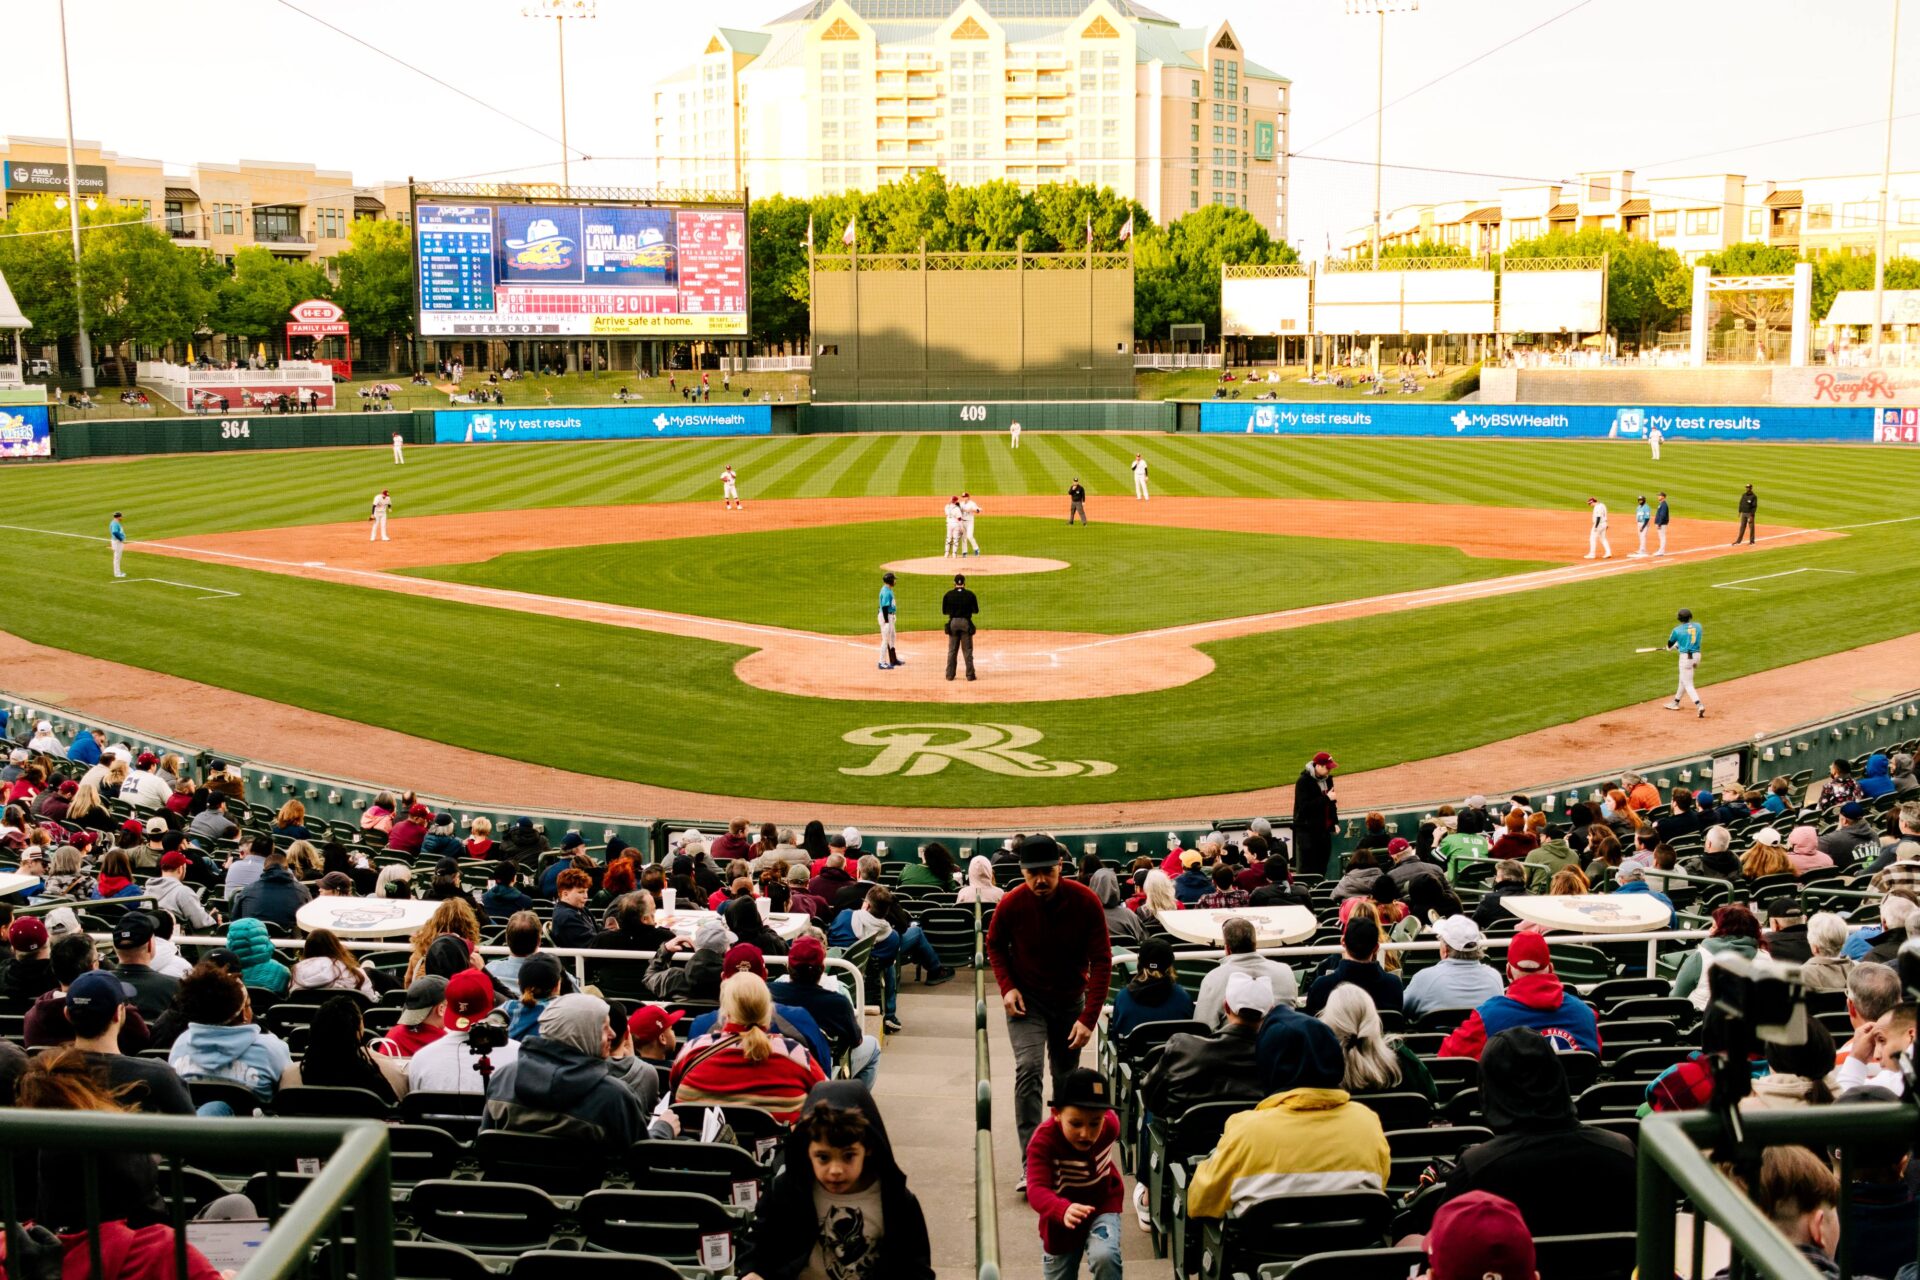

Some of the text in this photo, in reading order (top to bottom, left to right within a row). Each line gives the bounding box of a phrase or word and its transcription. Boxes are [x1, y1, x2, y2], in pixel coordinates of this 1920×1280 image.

[63, 178, 104, 187] COSSING
[586, 225, 614, 234] JORDAN
[616, 297, 650, 311] 2 0 1
[594, 316, 693, 326] Arrive safe at home.
[960, 405, 987, 421] 409
[1281, 412, 1372, 425] My test results
[1905, 410, 1916, 425] 0
[500, 417, 581, 430] My test results
[670, 414, 745, 427] MyBSWHealth
[1472, 414, 1569, 427] MyBSWHealth
[1650, 416, 1761, 430] My test results
[221, 420, 250, 438] 364
[1904, 428, 1914, 441] 4
[122, 777, 140, 793] 21
